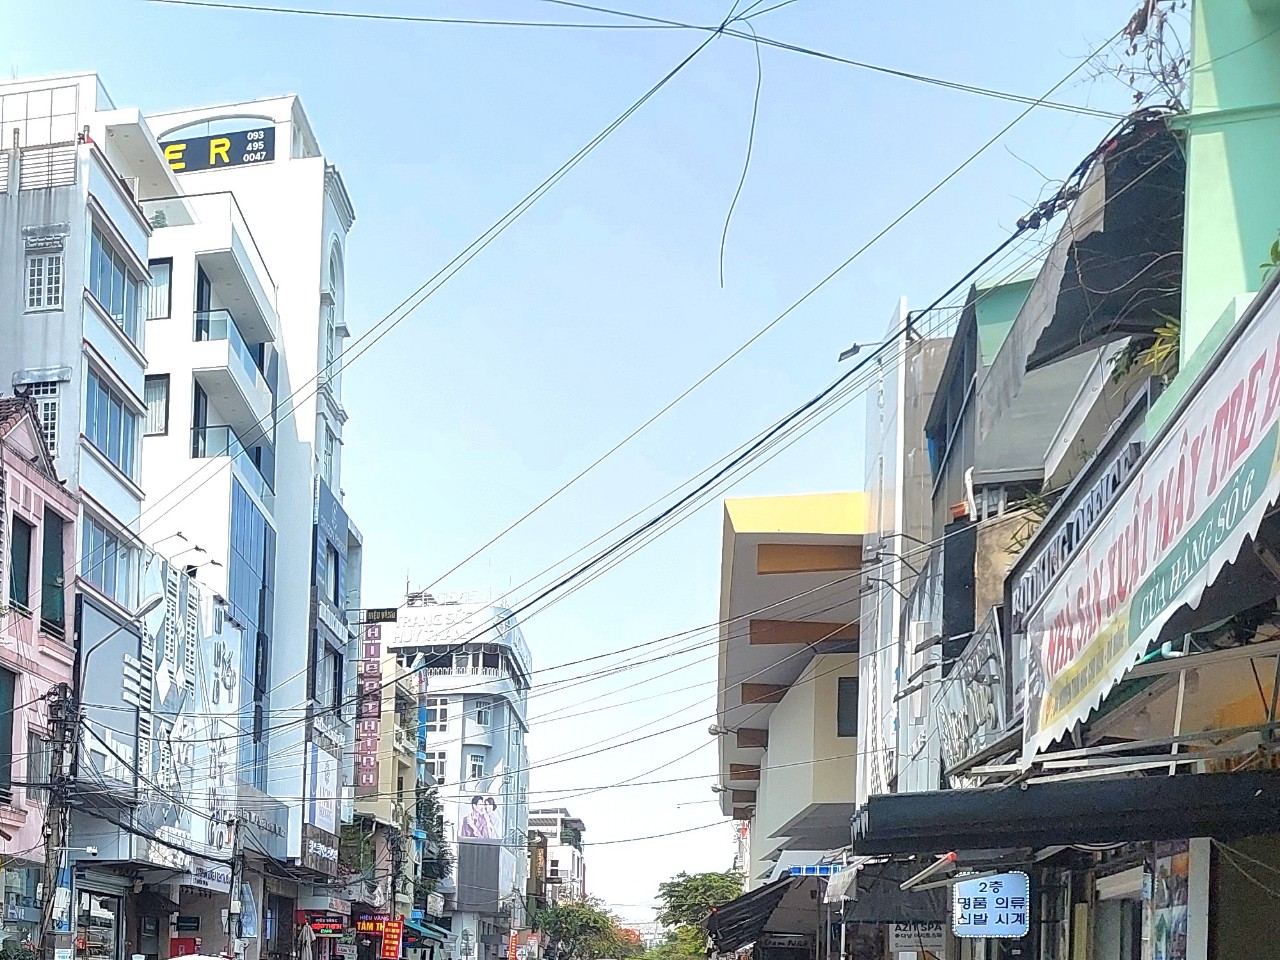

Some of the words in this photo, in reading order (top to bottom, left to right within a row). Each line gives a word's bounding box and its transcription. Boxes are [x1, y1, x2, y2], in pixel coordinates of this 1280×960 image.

[246, 130, 264, 140] 093
[246, 141, 264, 151] 495
[242, 151, 266, 162] 0047
[1153, 427, 1208, 564] MÂY
[1206, 348, 1267, 498] TRE
[1214, 463, 1245, 544] SỐ
[1242, 468, 1255, 512] 6
[978, 880, 1004, 894] 2층
[957, 896, 988, 910] 명품
[994, 896, 1026, 910] 의류
[957, 912, 989, 926] 신발
[994, 912, 1026, 926] 시계
[921, 922, 942, 932] SPA
